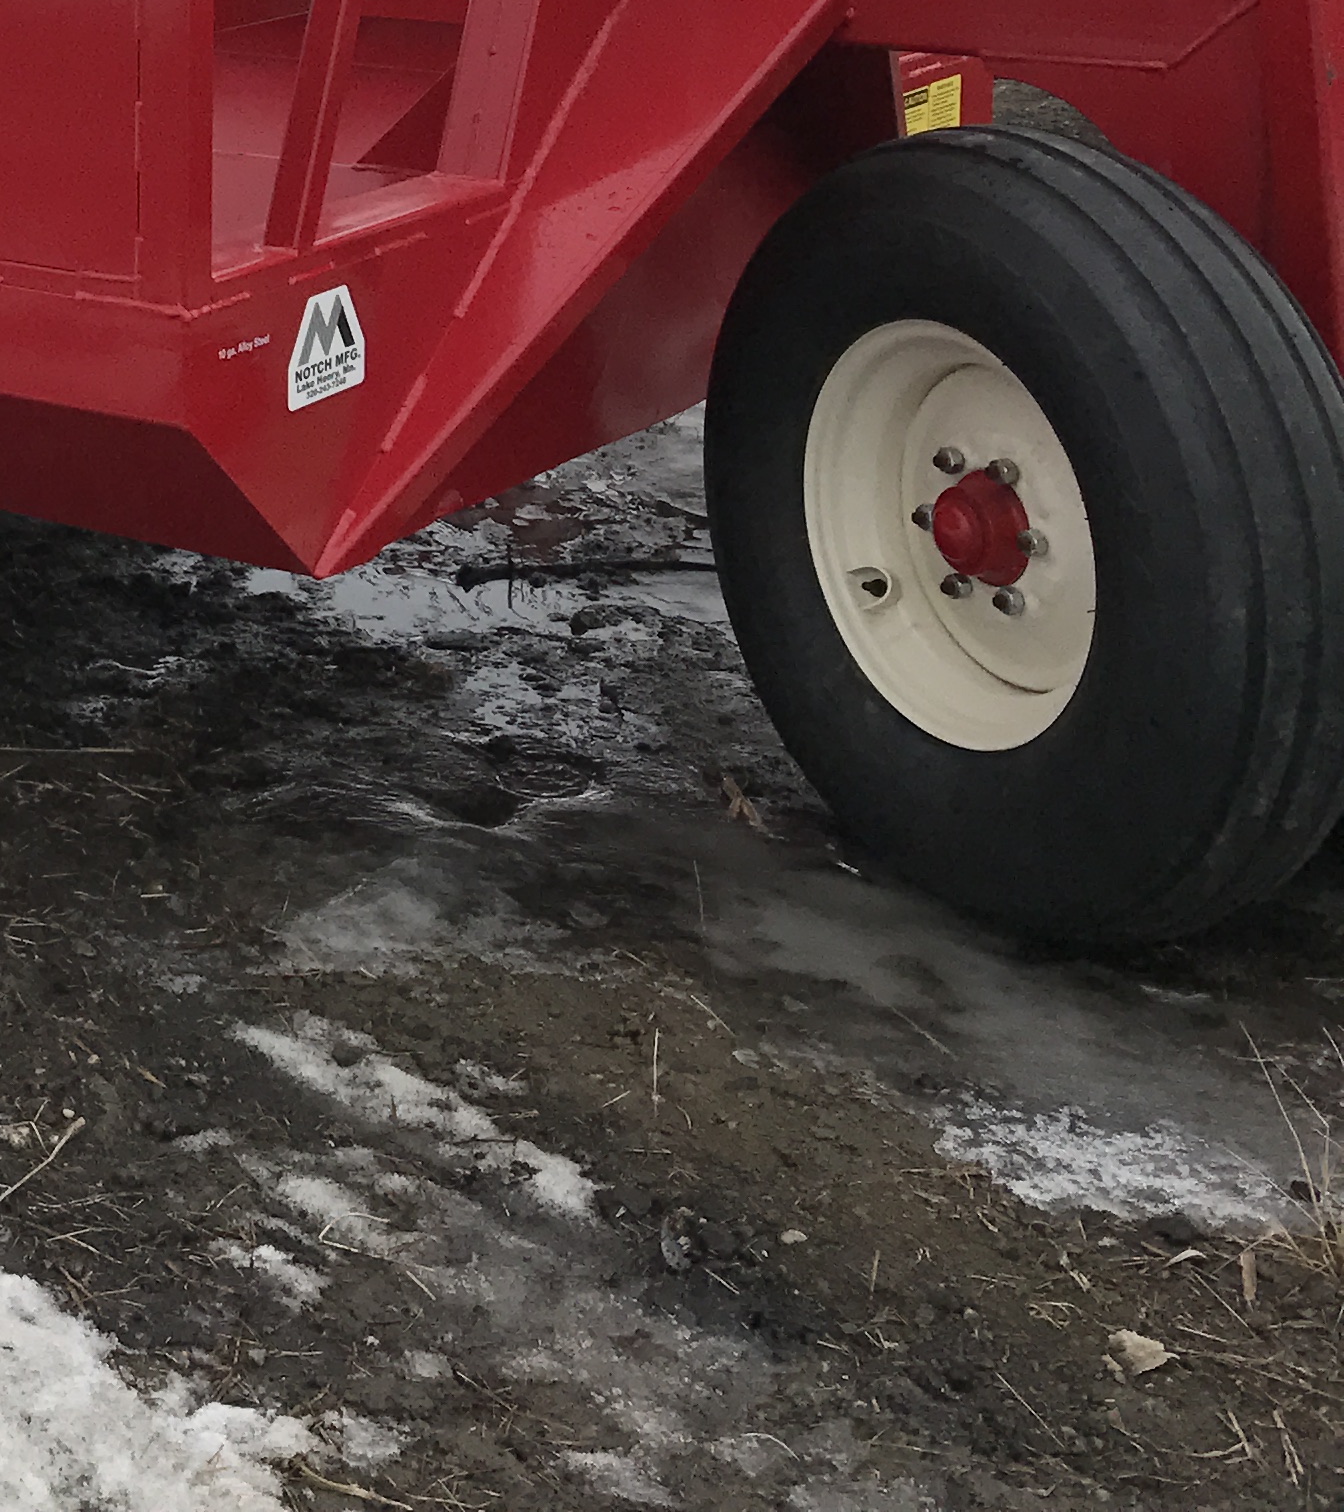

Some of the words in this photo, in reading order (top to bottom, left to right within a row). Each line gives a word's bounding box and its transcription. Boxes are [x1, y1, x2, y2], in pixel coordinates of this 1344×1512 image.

[253, 333, 270, 348] Steel
[295, 357, 332, 384] NOTCH
[296, 378, 315, 394] Lake
